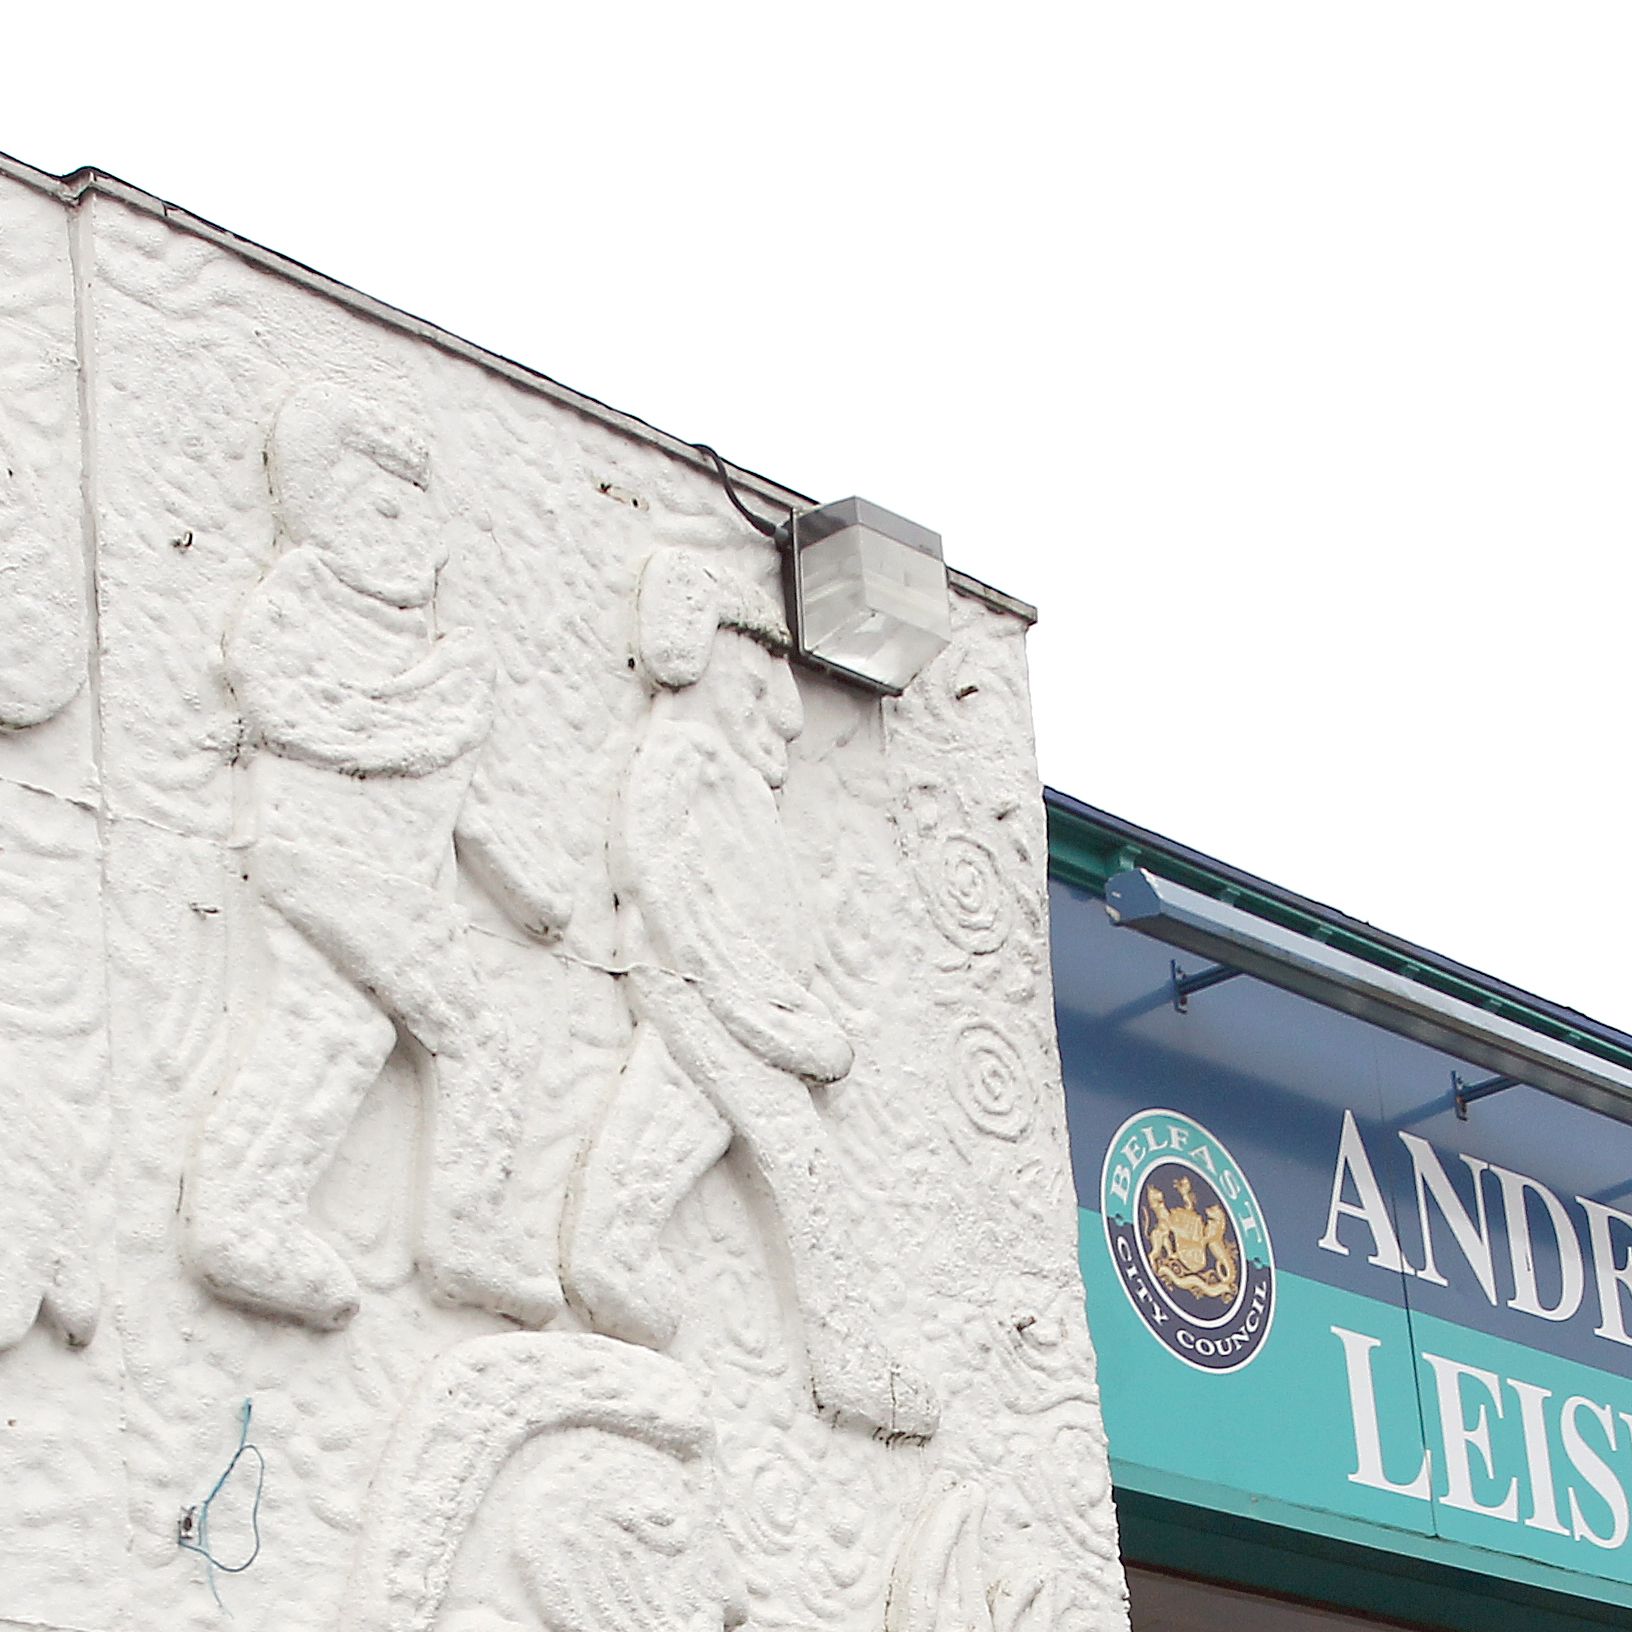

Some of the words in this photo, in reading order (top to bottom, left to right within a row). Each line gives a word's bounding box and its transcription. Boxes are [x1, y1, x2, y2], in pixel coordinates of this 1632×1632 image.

[1111, 1124, 1262, 1243] BELFAST
[1117, 1235, 1169, 1327] CITY
[1175, 1280, 1267, 1356] COUNCIL
